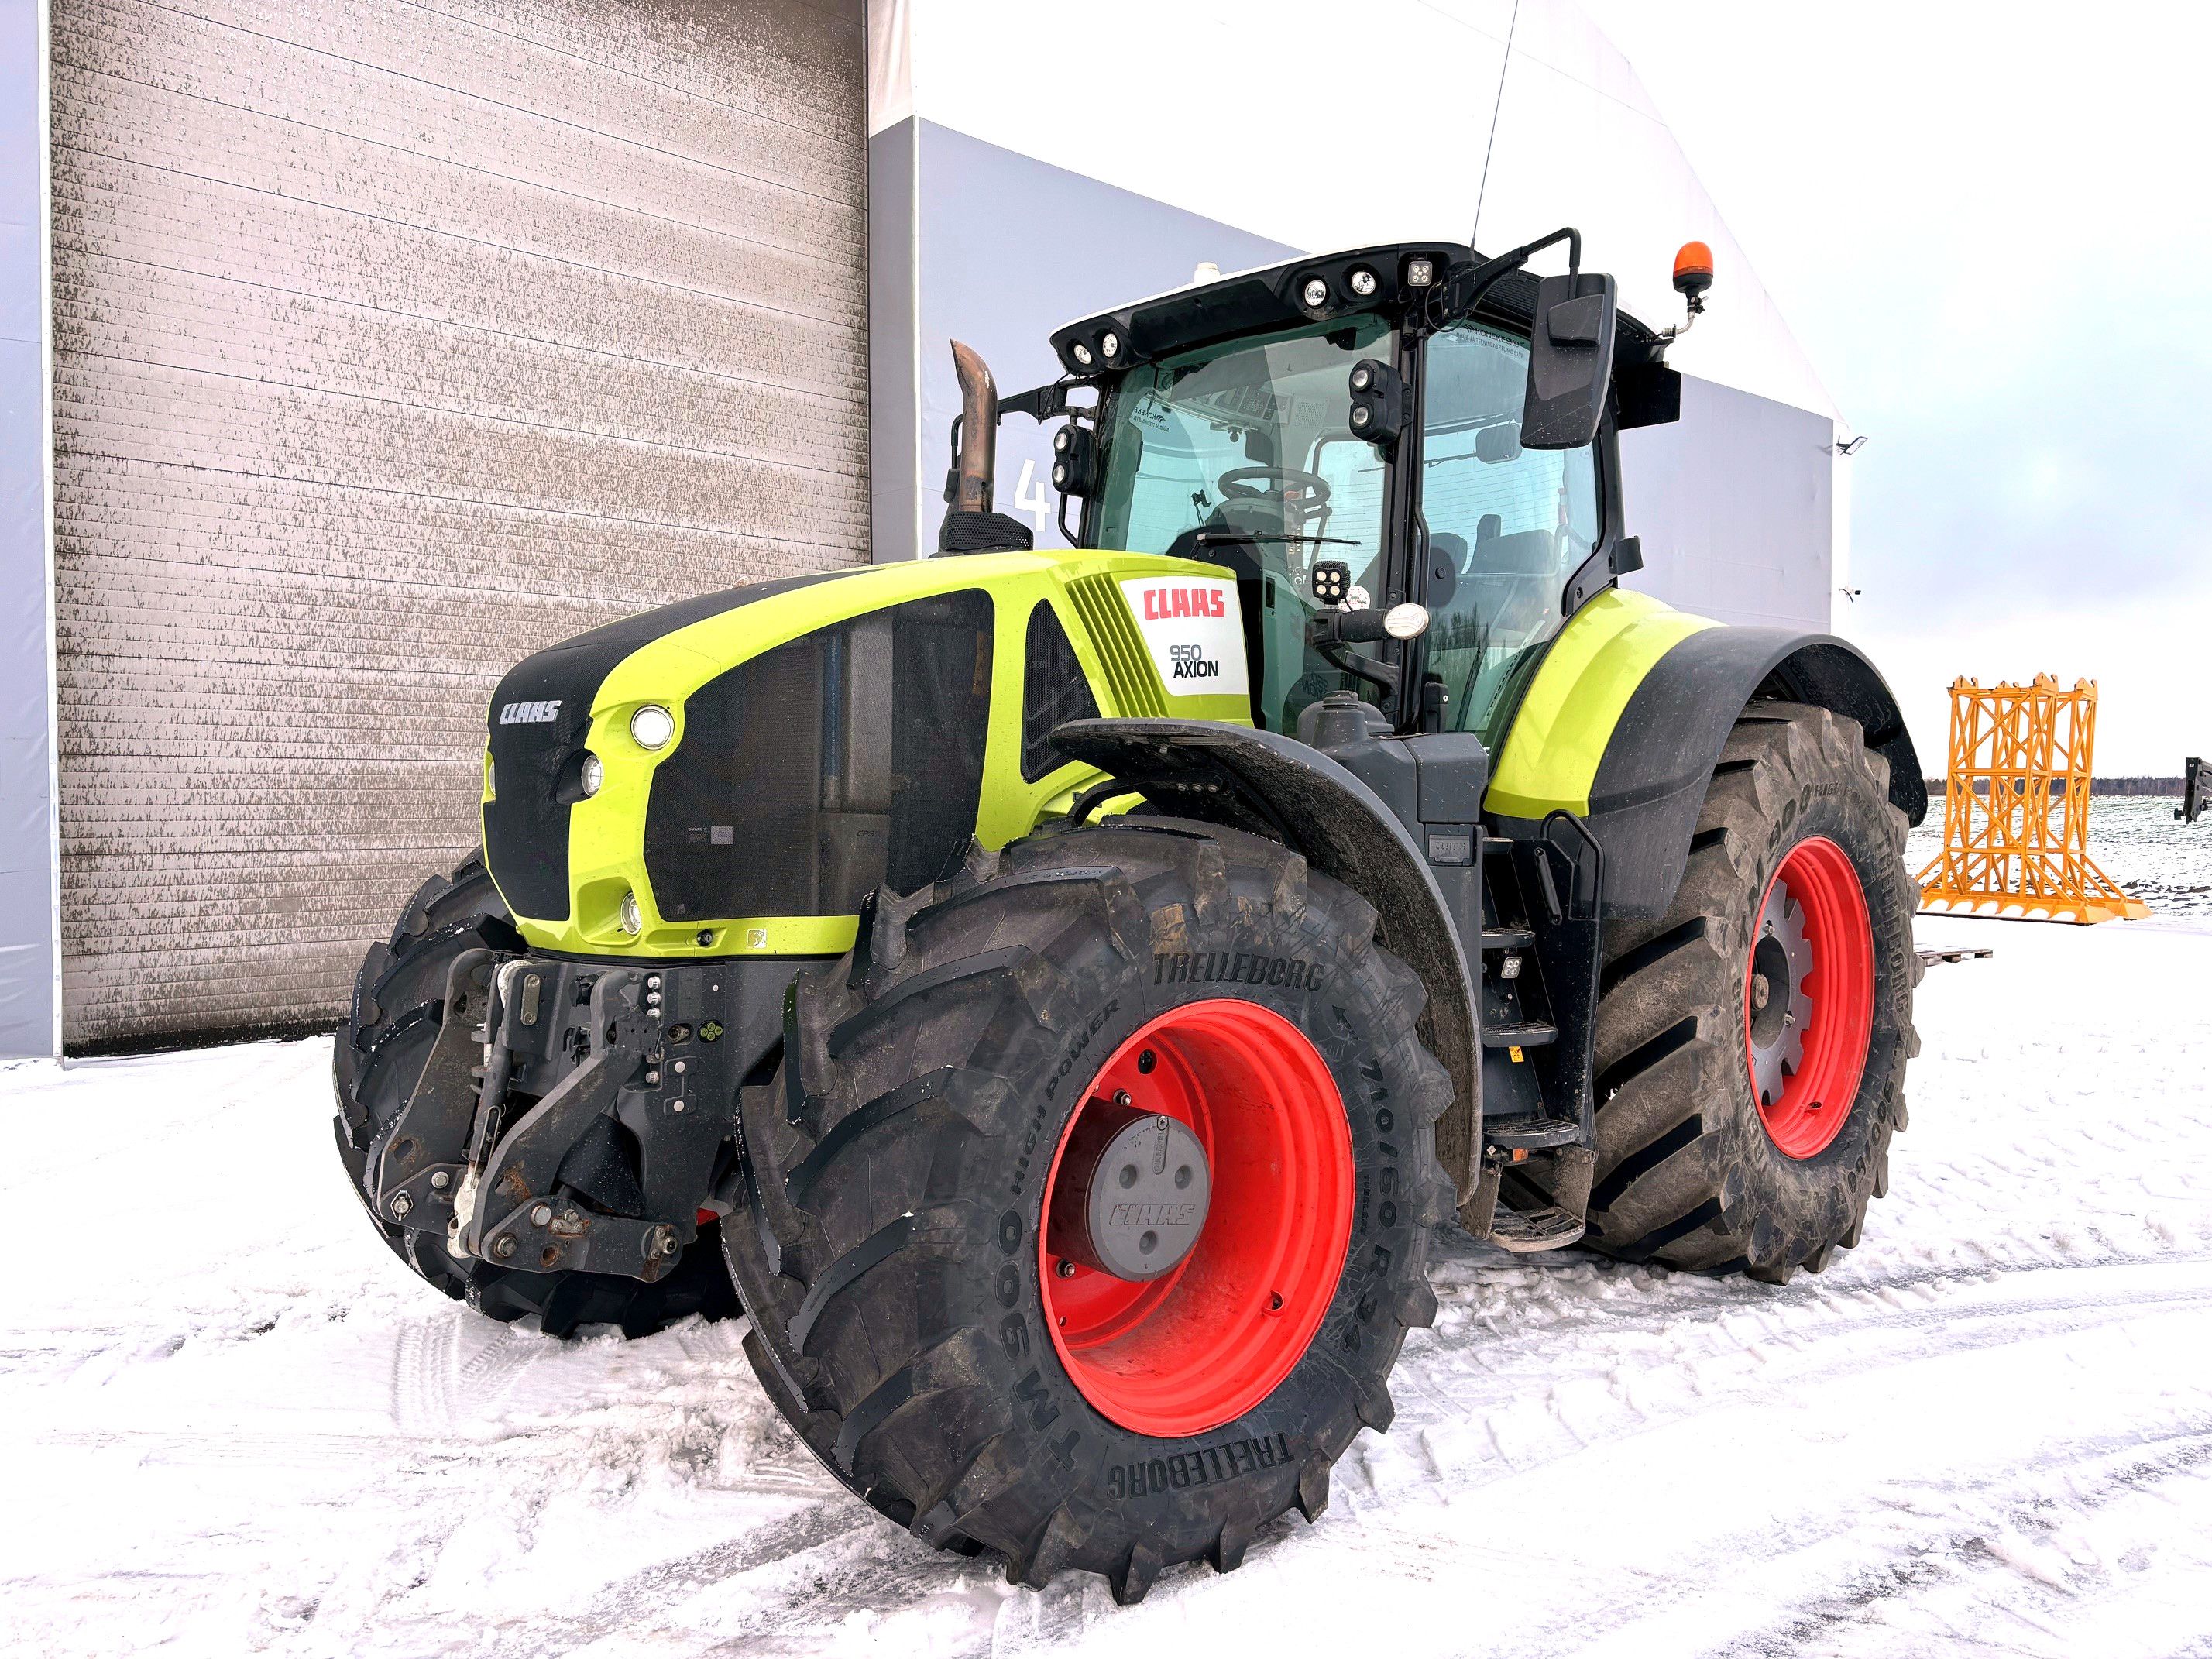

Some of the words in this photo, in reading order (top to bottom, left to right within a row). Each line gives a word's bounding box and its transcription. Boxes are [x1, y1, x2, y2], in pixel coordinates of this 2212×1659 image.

[1475, 327, 1520, 348] KONEKESKO
[1014, 459, 1051, 532] 4
[1144, 588, 1225, 620] CLAAS
[1170, 644, 1202, 662] 950
[1173, 660, 1219, 678] AXION
[499, 699, 562, 725] CLAAS
[1152, 952, 1326, 992] TRELLEBORG
[1046, 998, 1121, 1101] POWER
[1010, 1104, 1047, 1197] HIGH
[1108, 1204, 1197, 1226] CLAAS
[995, 1209, 1030, 1361] 900
[1013, 1367, 1082, 1472] TM
[1107, 1431, 1296, 1502] TRELLEBORG
